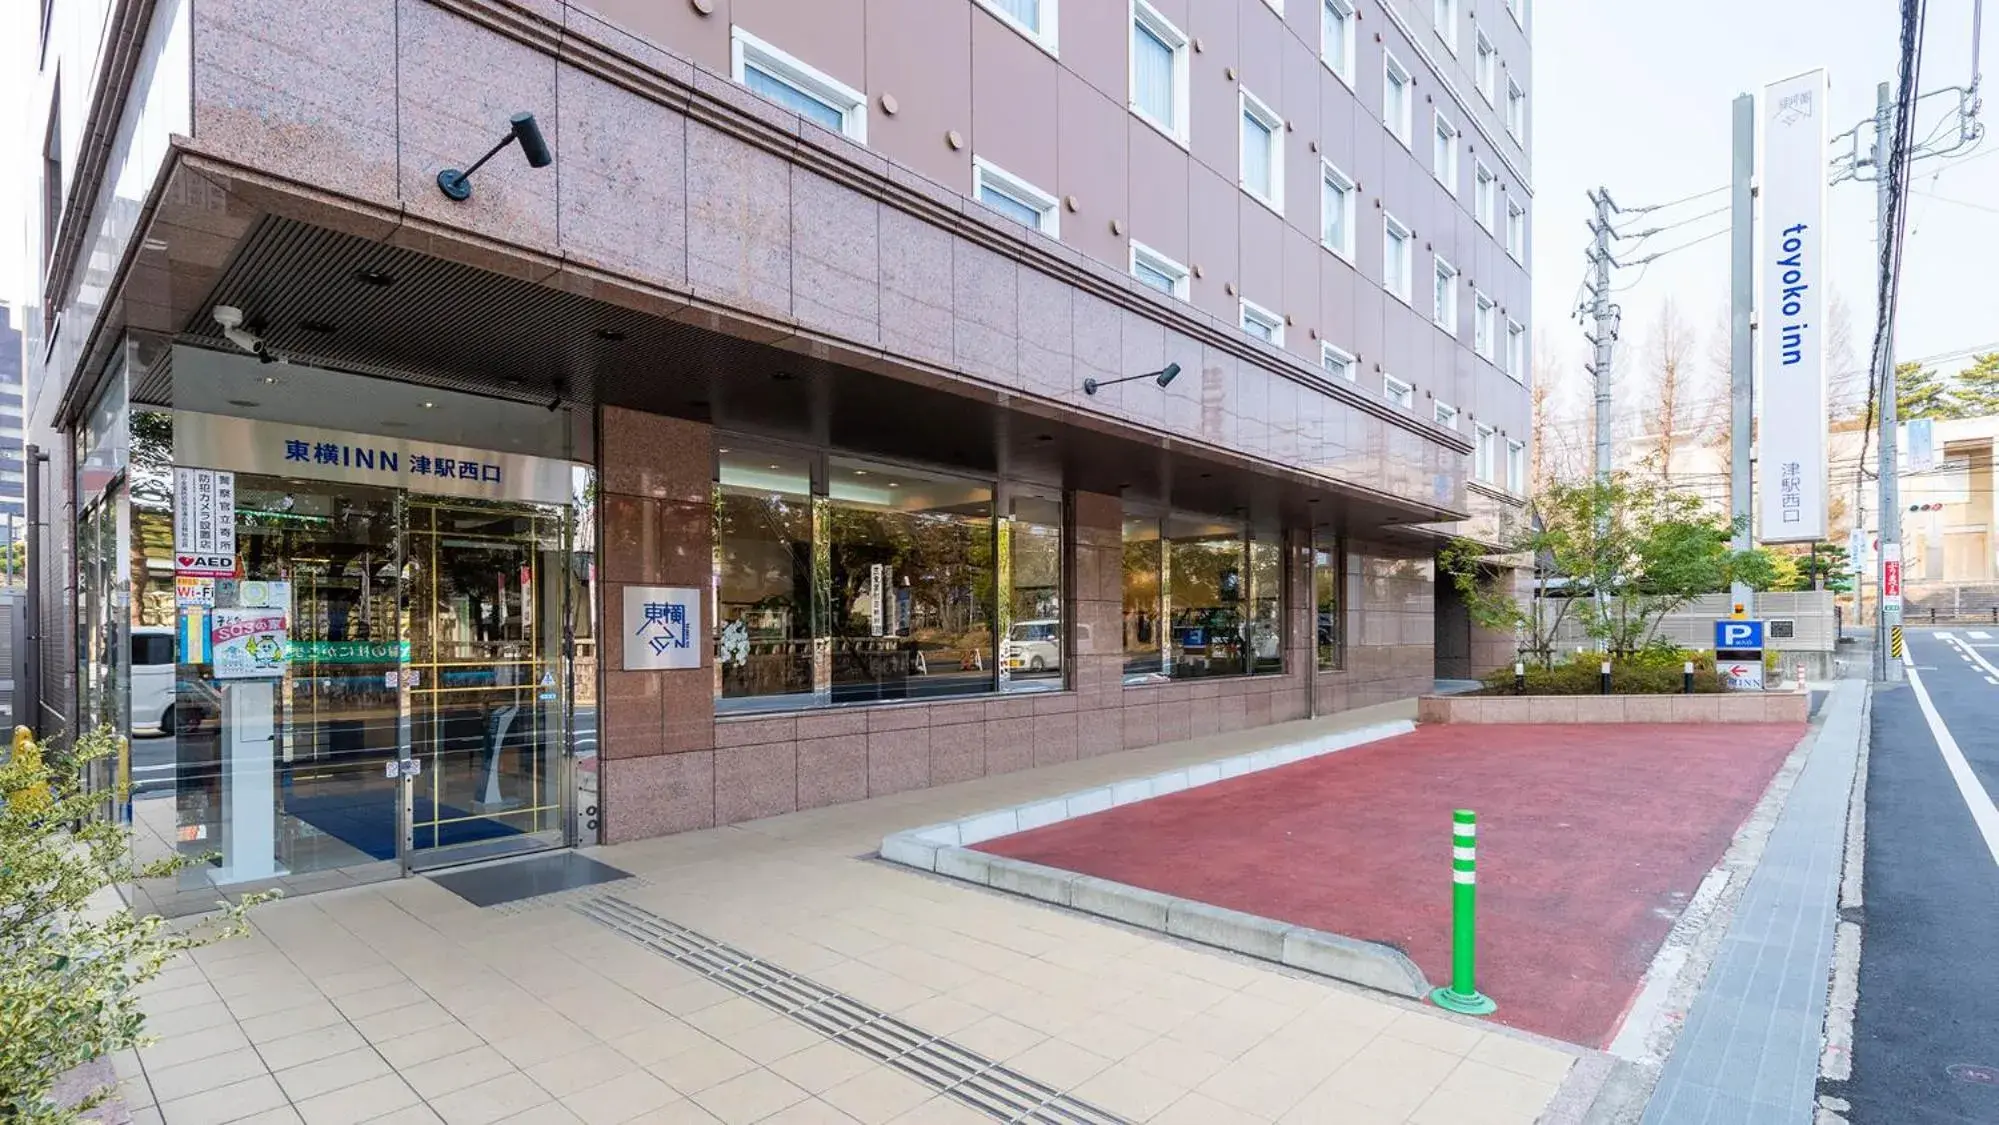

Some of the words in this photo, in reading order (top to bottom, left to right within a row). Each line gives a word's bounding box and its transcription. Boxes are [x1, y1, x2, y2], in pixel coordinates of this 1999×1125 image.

[1777, 224, 1808, 316] toyoko
[1783, 324, 1808, 365] inn
[285, 440, 398, 472] 東横INN
[409, 454, 501, 483] 津駅西口
[199, 474, 211, 549] 防犯カメラ設置店
[218, 475, 231, 550] 警察官立寄所
[1781, 462, 1800, 523] 津駅西口
[194, 557, 233, 567] AED
[177, 587, 214, 597] Wi-Fi
[1725, 624, 1752, 645] P
